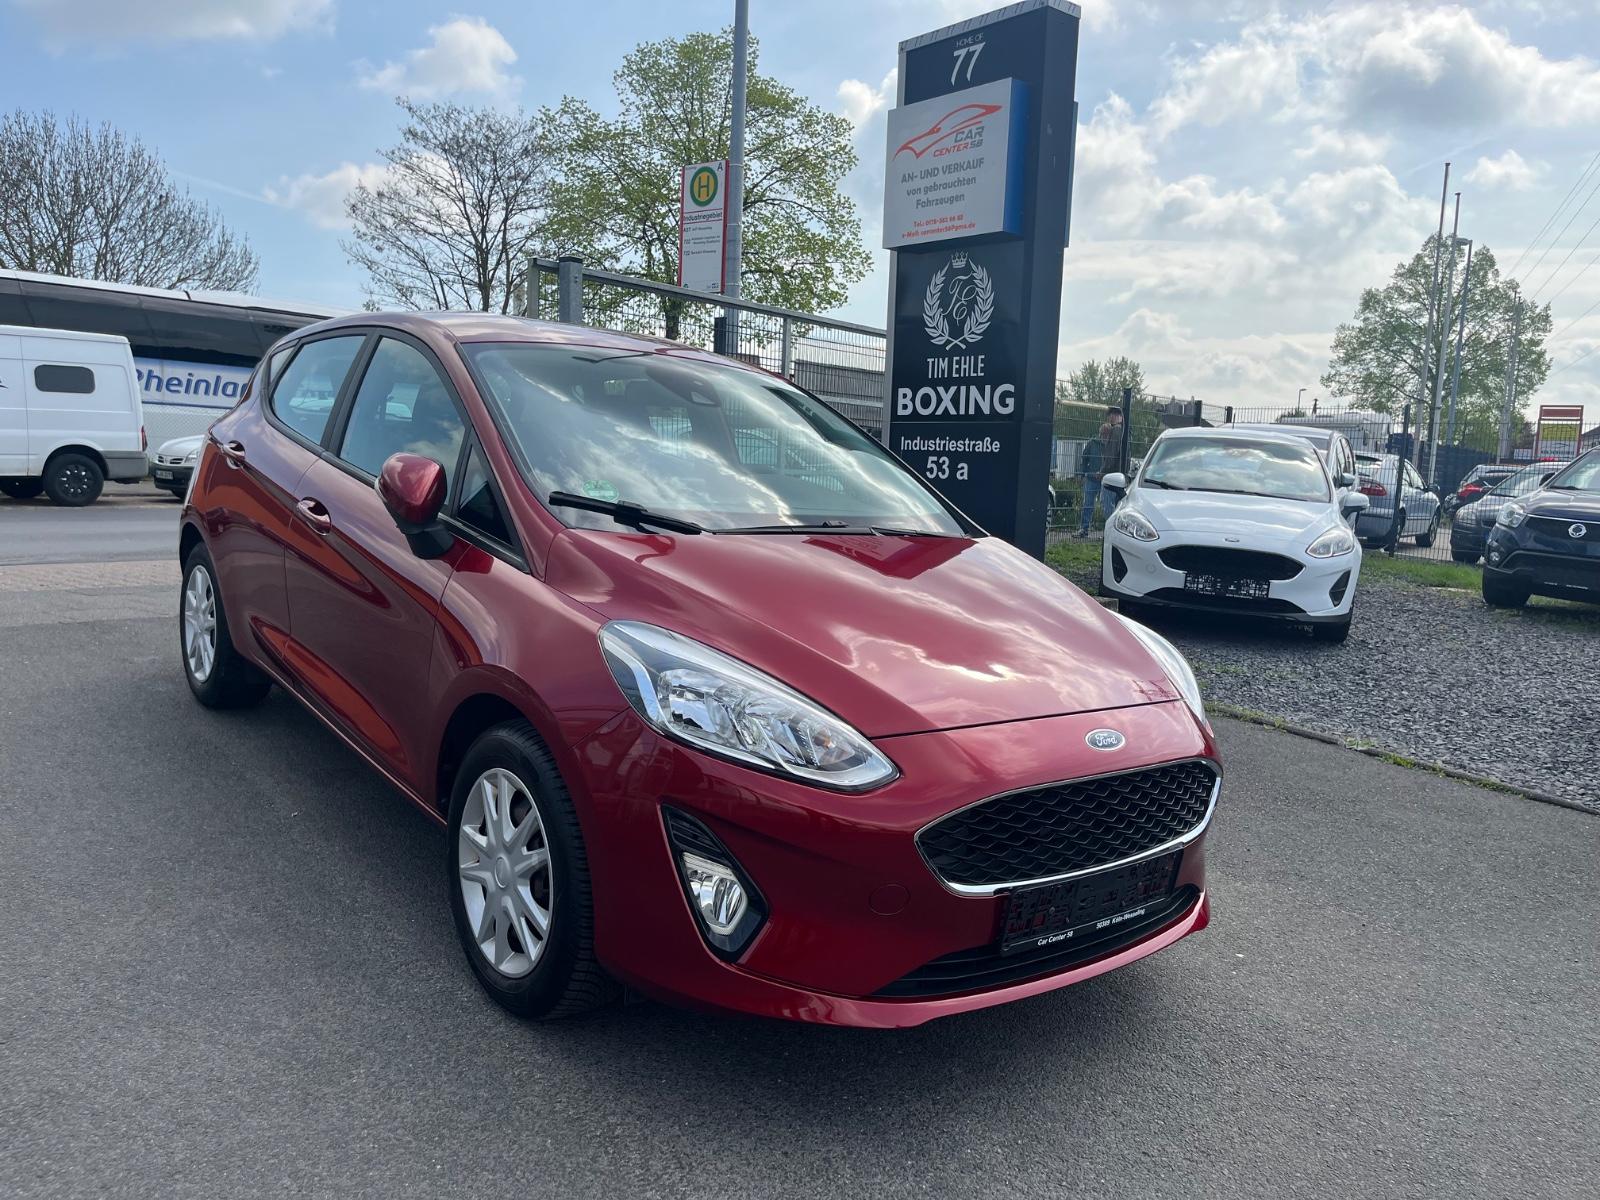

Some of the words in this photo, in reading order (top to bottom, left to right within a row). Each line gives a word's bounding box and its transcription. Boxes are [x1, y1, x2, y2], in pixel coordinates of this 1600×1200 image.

[951, 42, 986, 87] 77
[954, 126, 985, 143] CAR
[717, 162, 724, 171] A
[901, 172, 918, 184] AN-
[919, 167, 940, 180] UND
[941, 157, 985, 175] VERKAUF
[906, 187, 922, 197] von
[923, 176, 977, 195] gebrauchten
[916, 193, 966, 209] Fahrzeugen
[927, 357, 948, 379] TIM
[953, 355, 985, 378] EHLE
[897, 384, 1015, 416] BOXING
[901, 436, 1000, 453] Industriestraße
[926, 456, 950, 479] 53
[956, 461, 968, 480] a
[1095, 732, 1118, 747] Ford
[1037, 938, 1048, 946] Car
[1048, 934, 1067, 943] Center
